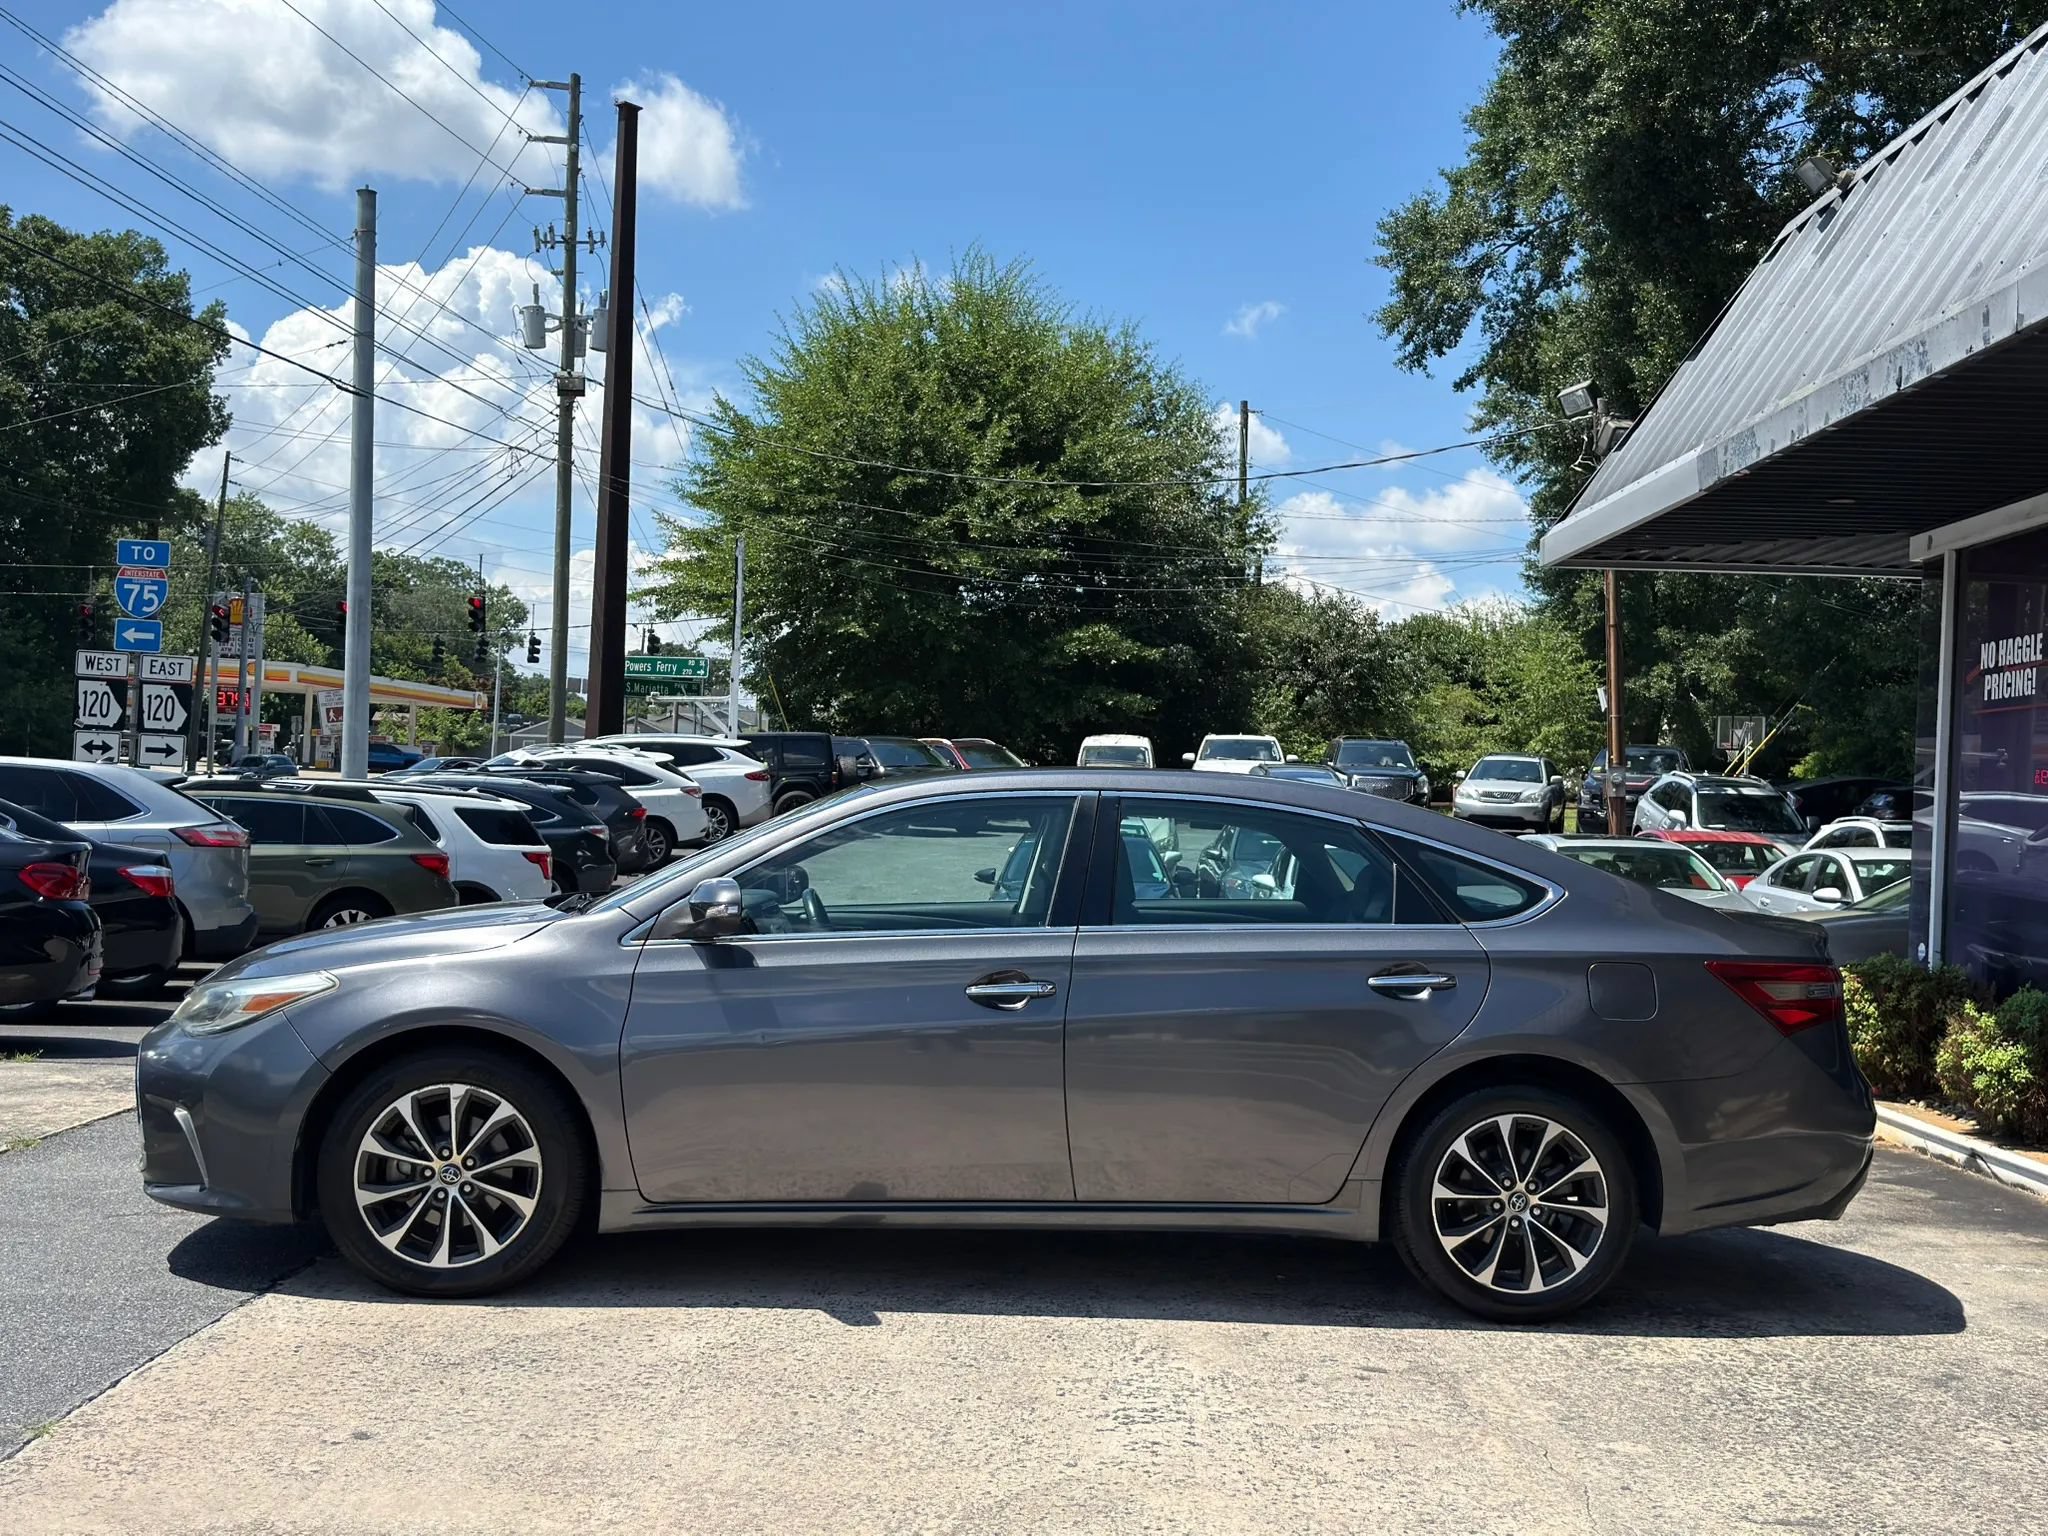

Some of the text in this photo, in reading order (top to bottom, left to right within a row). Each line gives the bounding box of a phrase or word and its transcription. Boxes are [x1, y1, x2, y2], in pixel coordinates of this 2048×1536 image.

[131, 546, 155, 561] TO
[124, 569, 160, 578] INTERSTATE
[124, 583, 159, 612] 75
[1980, 633, 2043, 670] NO HAGGLE
[85, 655, 121, 672] WEST
[149, 659, 184, 676] EAST
[625, 660, 677, 675] Powers Ferry
[1984, 667, 2037, 701] PRICING!
[82, 690, 111, 718] 120
[147, 694, 175, 722] 120
